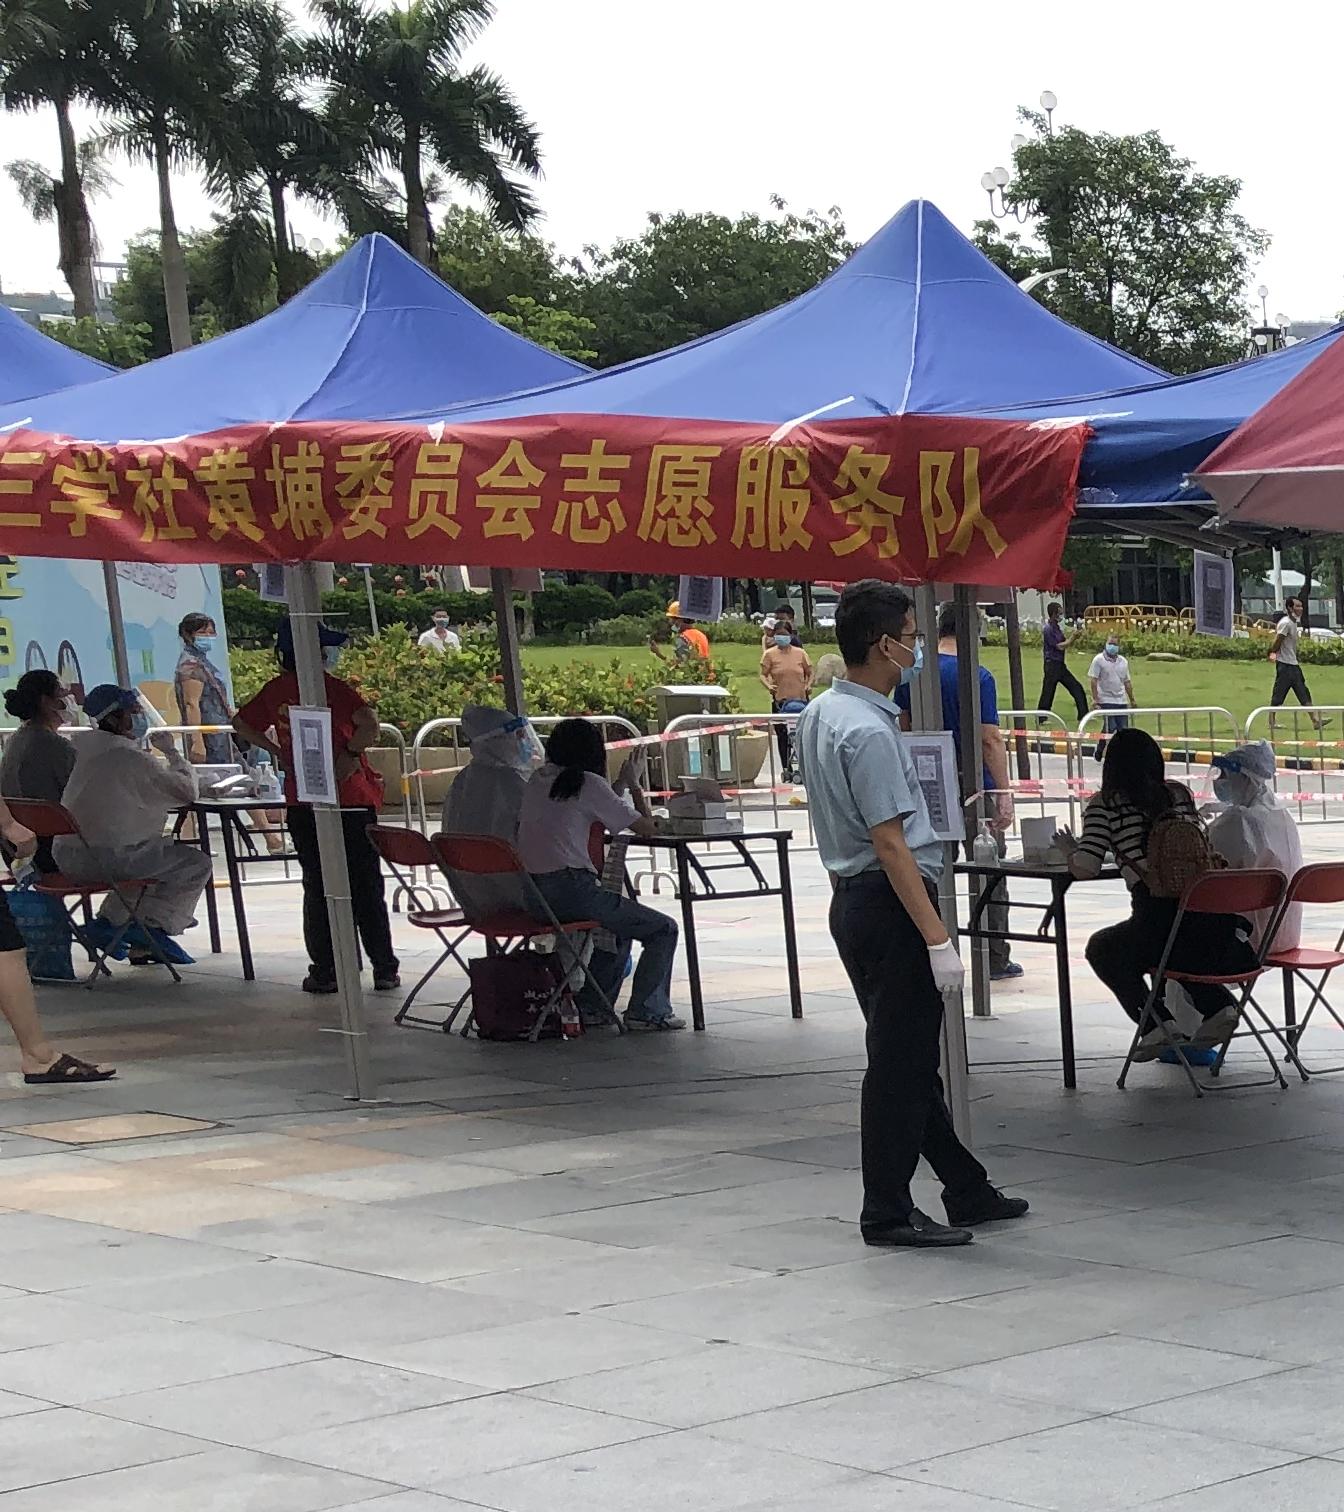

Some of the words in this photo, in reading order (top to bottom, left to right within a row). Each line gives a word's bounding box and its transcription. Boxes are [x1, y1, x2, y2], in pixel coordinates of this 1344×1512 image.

[0, 439, 1006, 560] 三学社黄埔委员会志愿服务队
